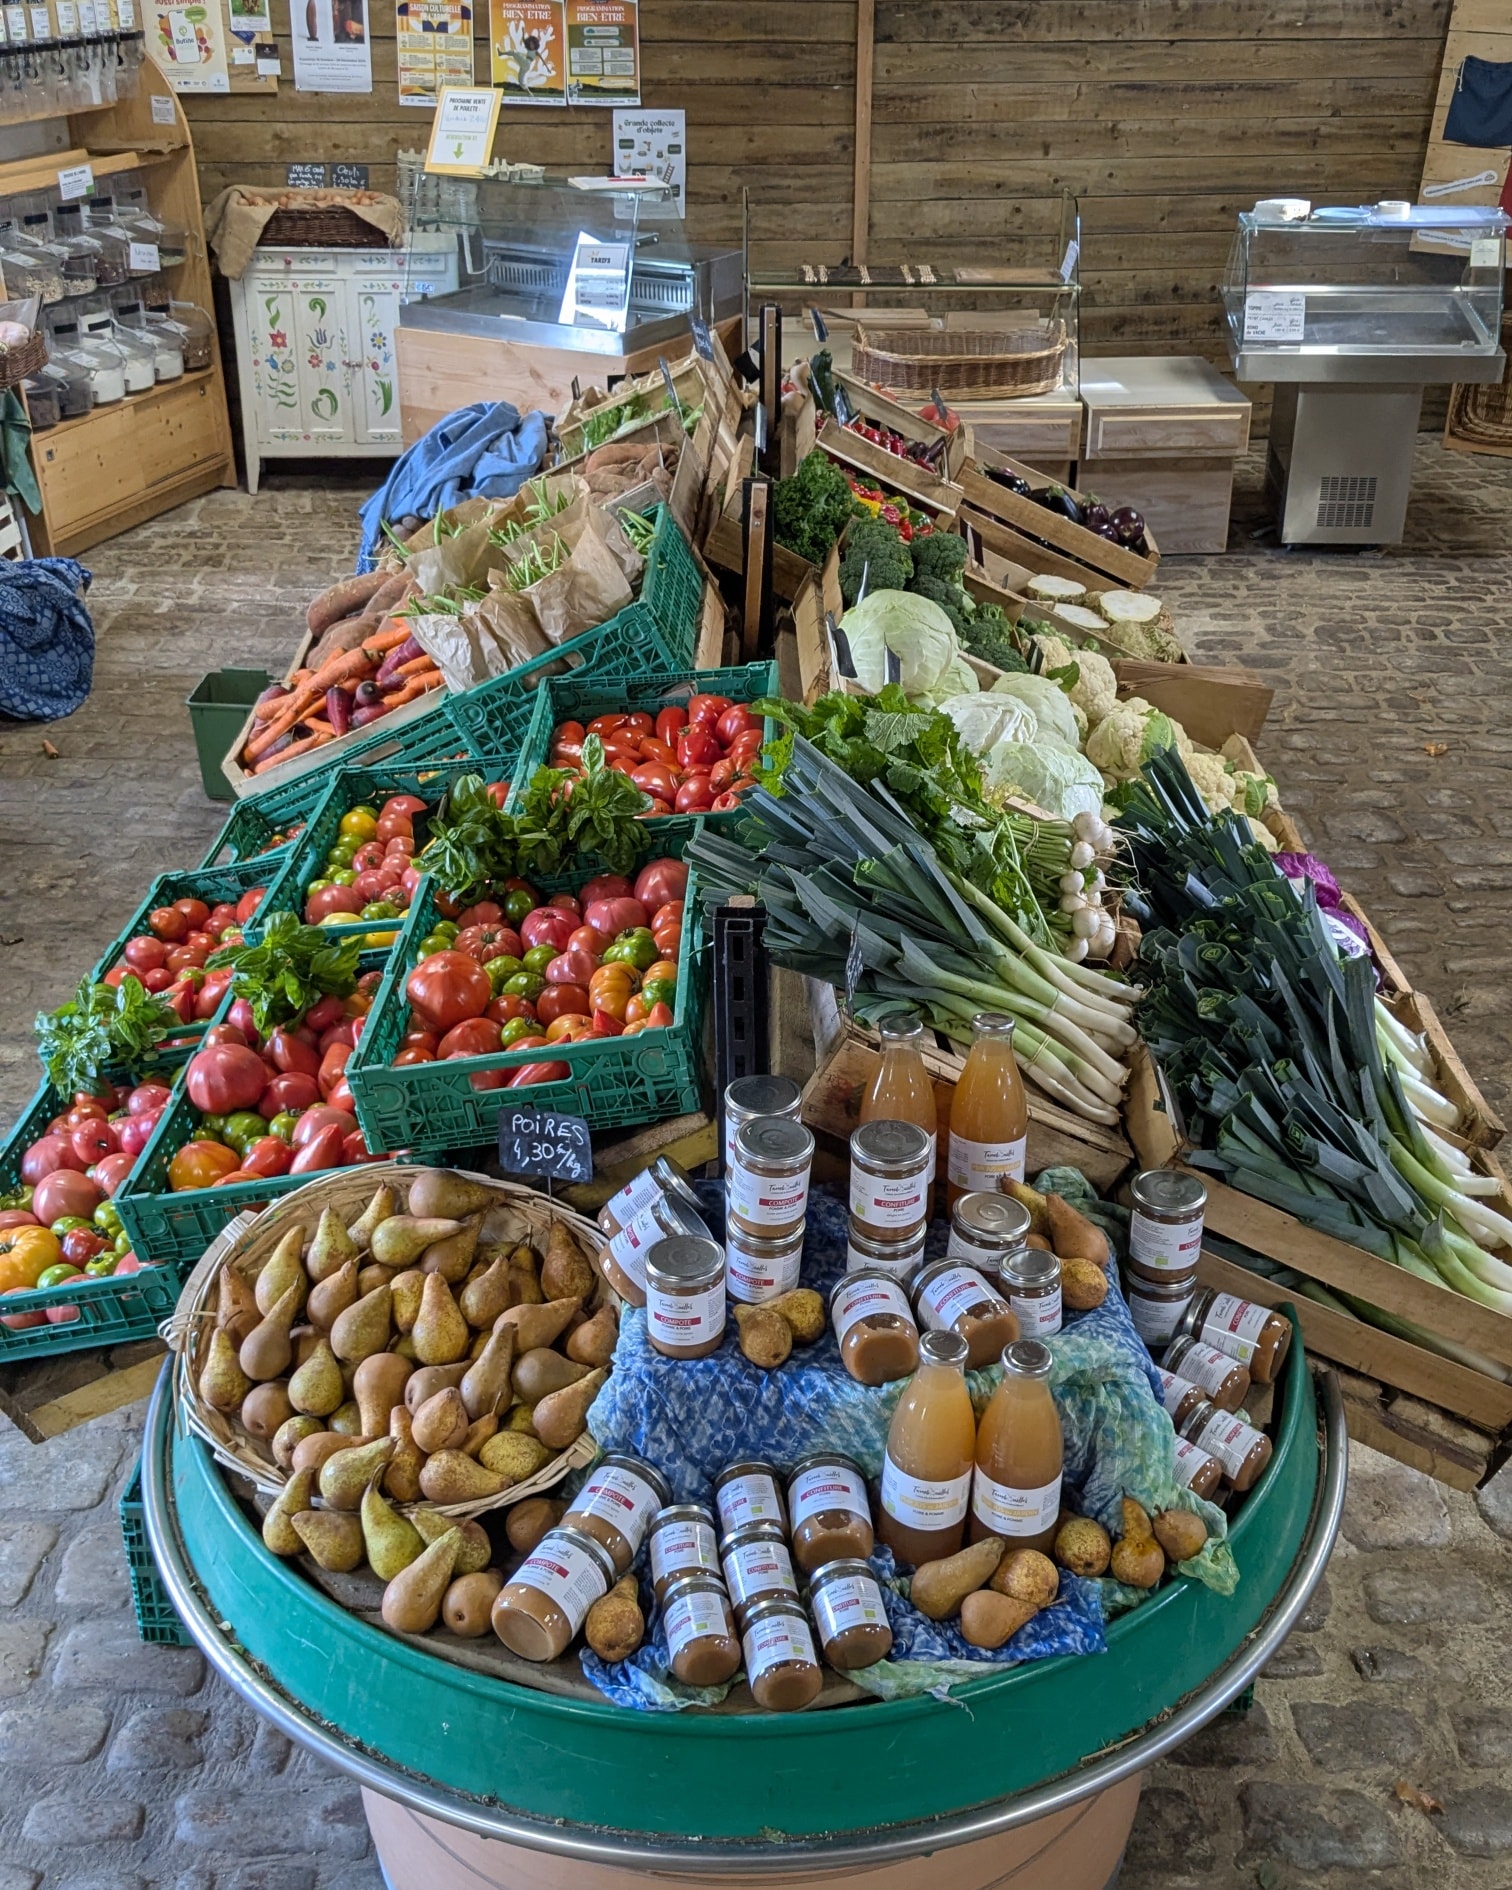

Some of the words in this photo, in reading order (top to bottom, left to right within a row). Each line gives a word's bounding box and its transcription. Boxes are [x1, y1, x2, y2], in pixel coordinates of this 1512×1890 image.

[409, 3, 429, 13] SAISON
[429, 4, 462, 14] CULTURELLE
[503, 2, 551, 10] PROGRAMMATION
[623, 119, 649, 127] Grande
[649, 119, 675, 129] collecte
[512, 1114, 584, 1145] POIRES
[768, 1196, 799, 1207] COMPOTE
[881, 1199, 915, 1209] CONFITURE
[735, 1273, 765, 1287] COMPOTE
[940, 1284, 970, 1307] CONFITURE
[848, 1294, 881, 1309] CONFITURE
[660, 1316, 692, 1326] COMPOTE
[806, 1485, 842, 1497] CONFITURE
[665, 1542, 693, 1553] CONFITURE
[530, 1559, 560, 1573] COMPOTE
